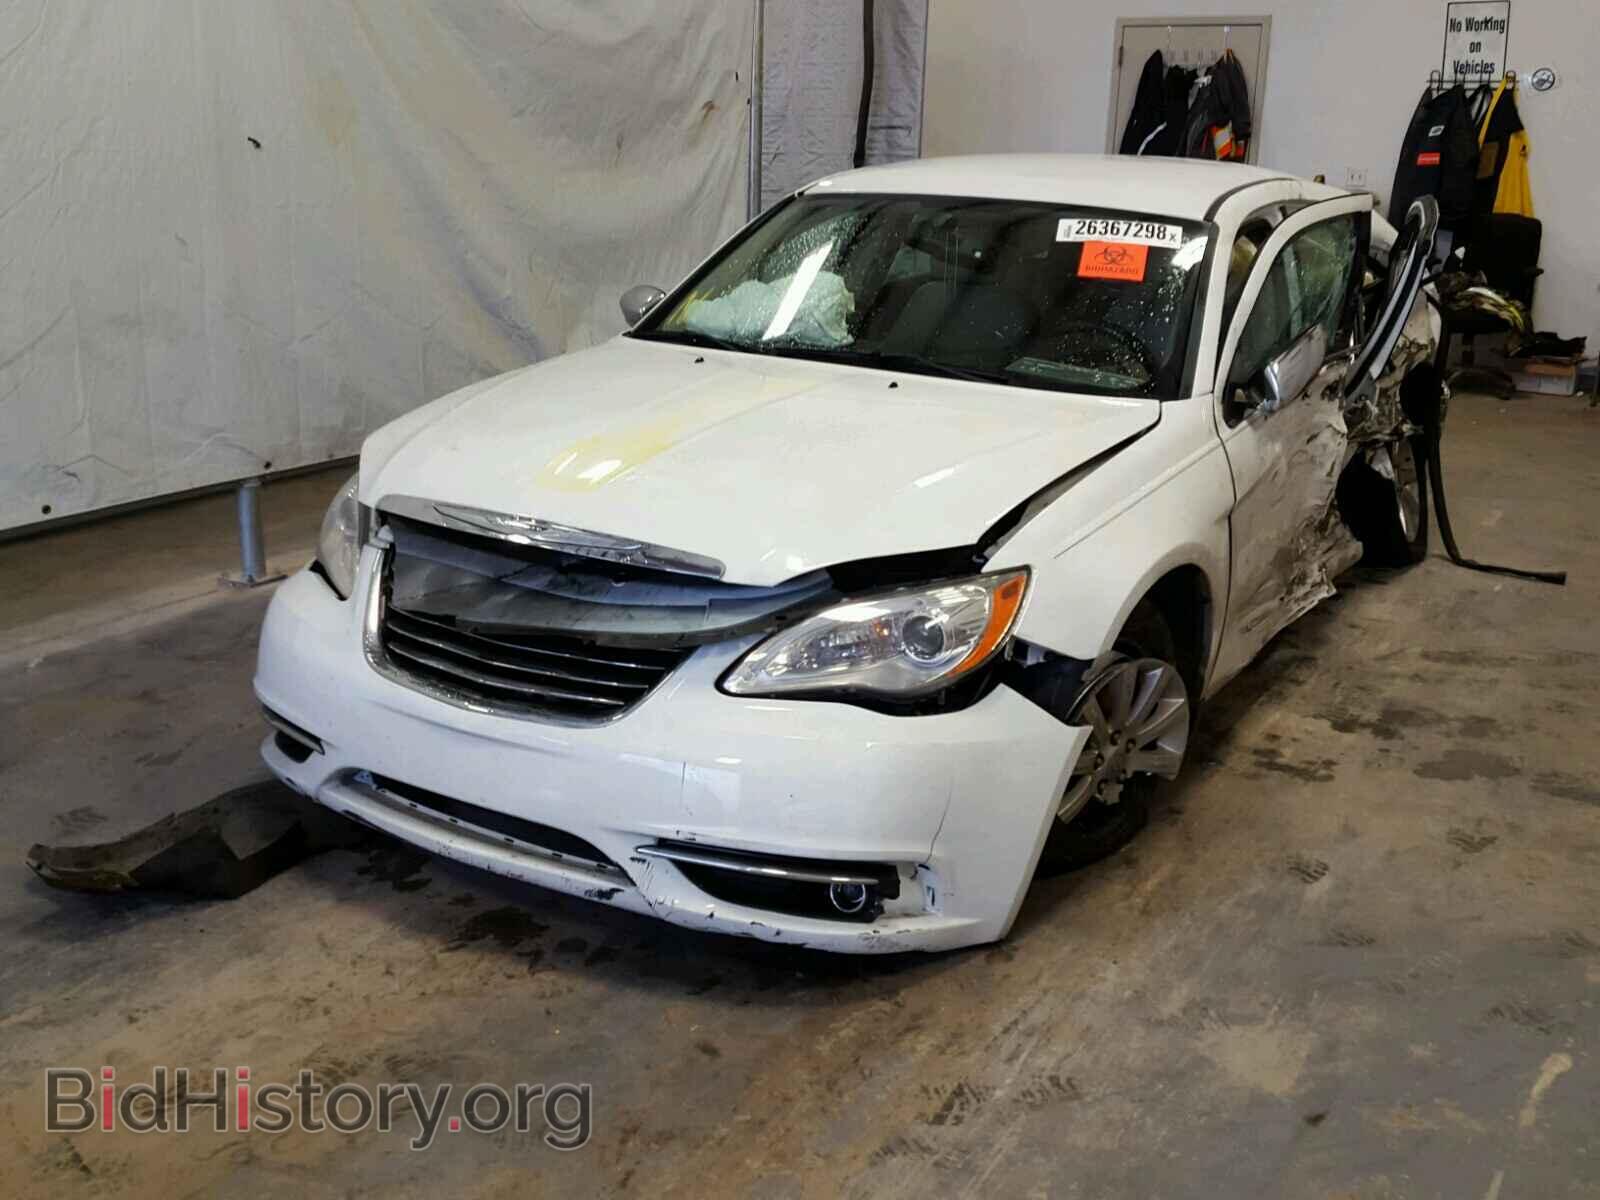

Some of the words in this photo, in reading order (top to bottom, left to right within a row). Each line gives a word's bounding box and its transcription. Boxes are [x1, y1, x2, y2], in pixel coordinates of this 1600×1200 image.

[1450, 18, 1461, 32] No
[1465, 16, 1505, 34] Working
[1469, 41, 1481, 53] on
[1453, 60, 1495, 75] Vehicles
[1075, 220, 1167, 240] 26367298
